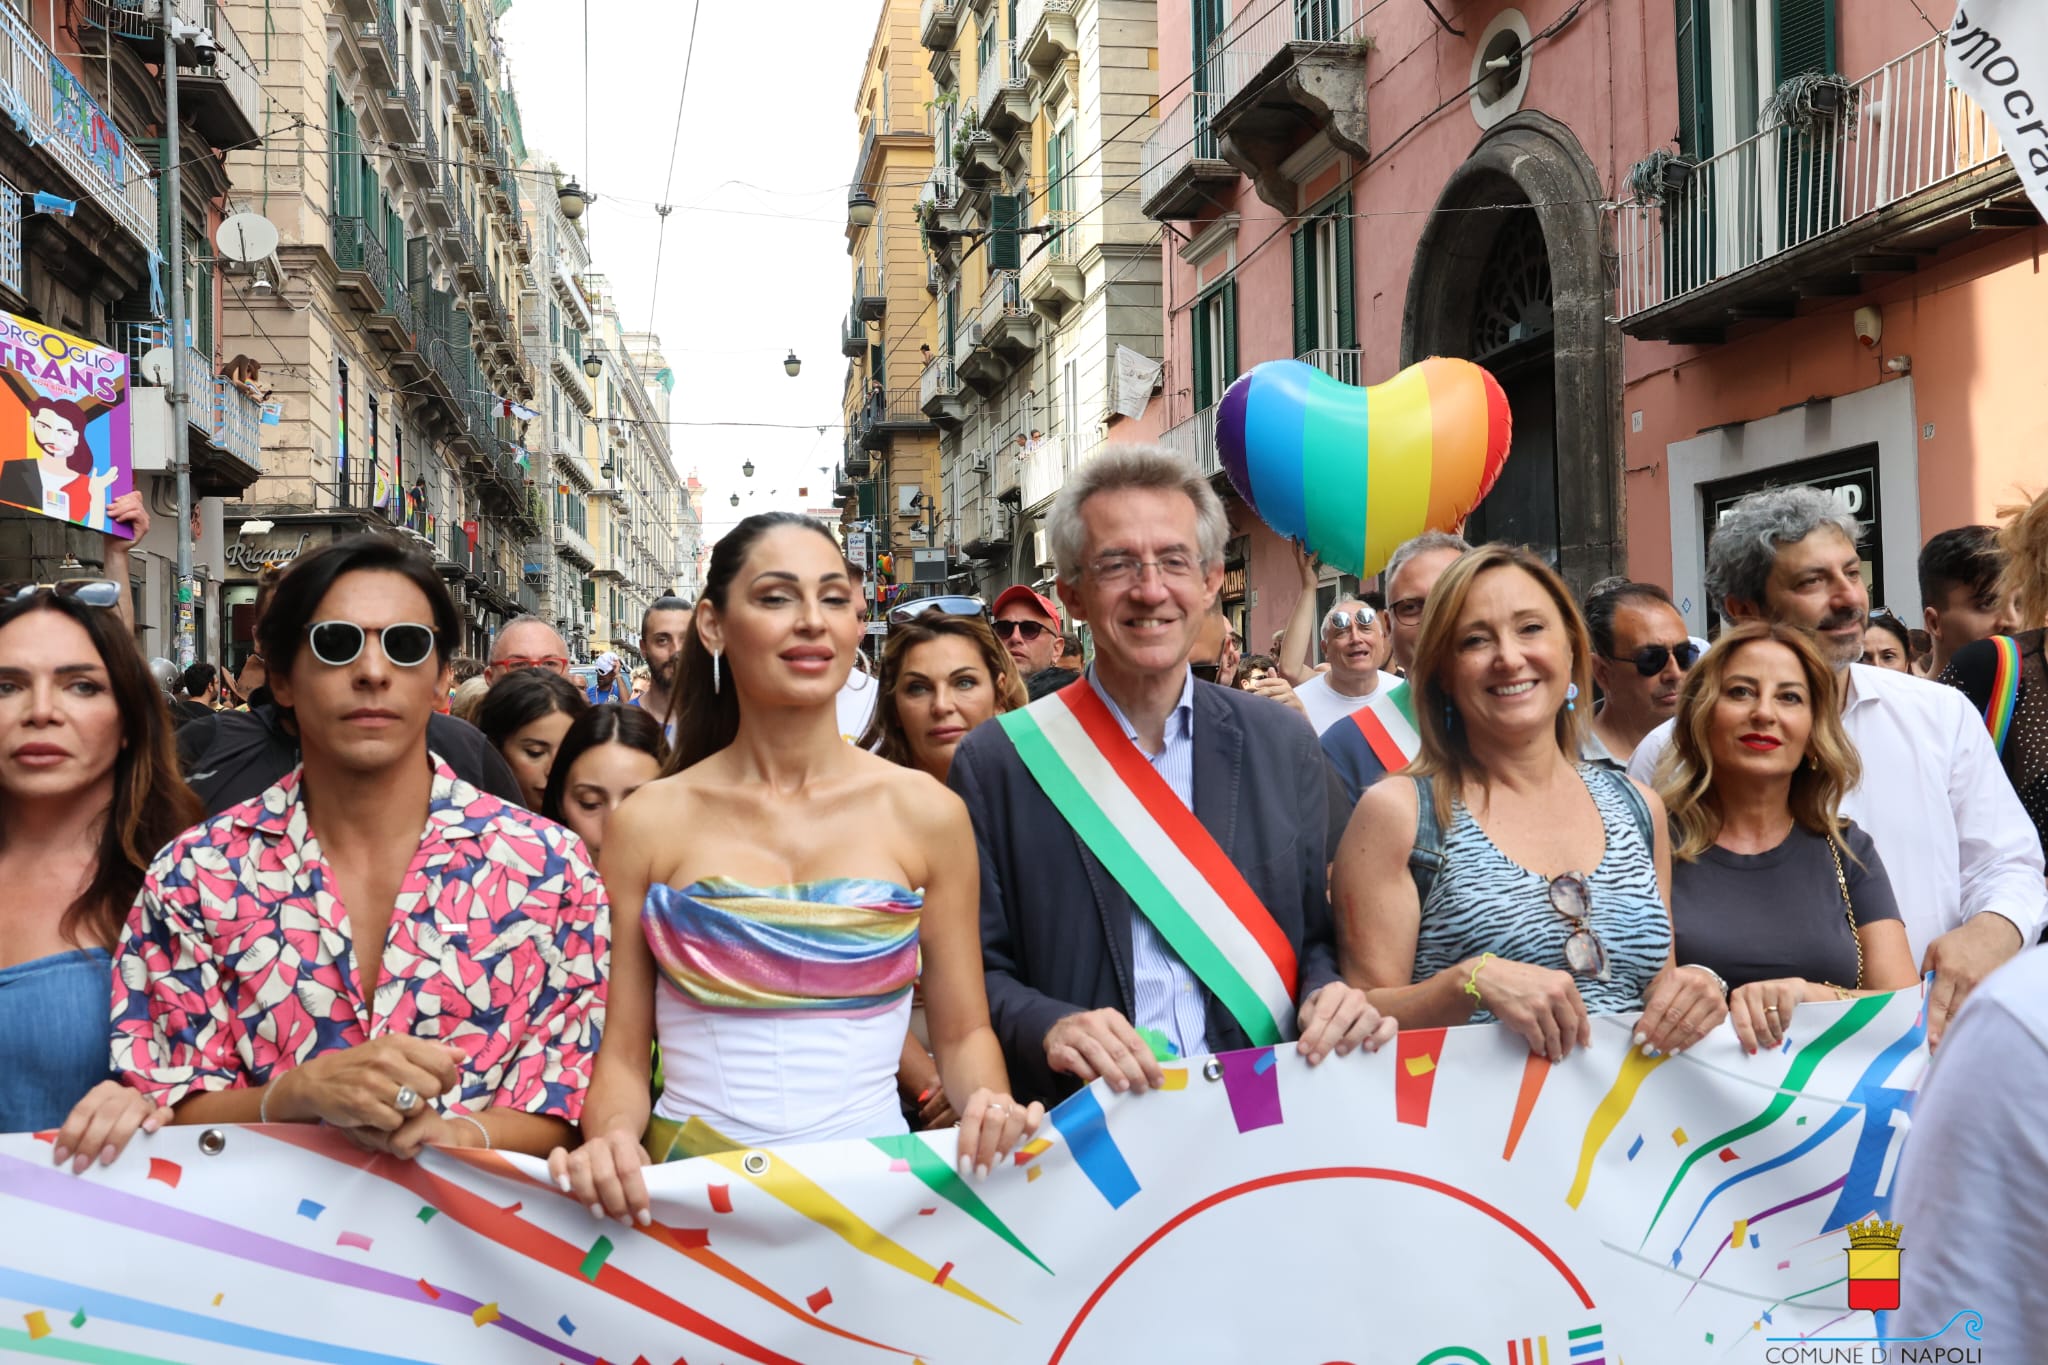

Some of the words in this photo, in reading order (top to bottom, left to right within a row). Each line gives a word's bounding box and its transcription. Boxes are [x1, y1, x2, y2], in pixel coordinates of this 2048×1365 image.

[1951, 9, 2048, 192] mocra
[0, 320, 115, 373] ORGOGLIO
[0, 341, 116, 401] TRANS
[225, 533, 309, 572] Riccard
